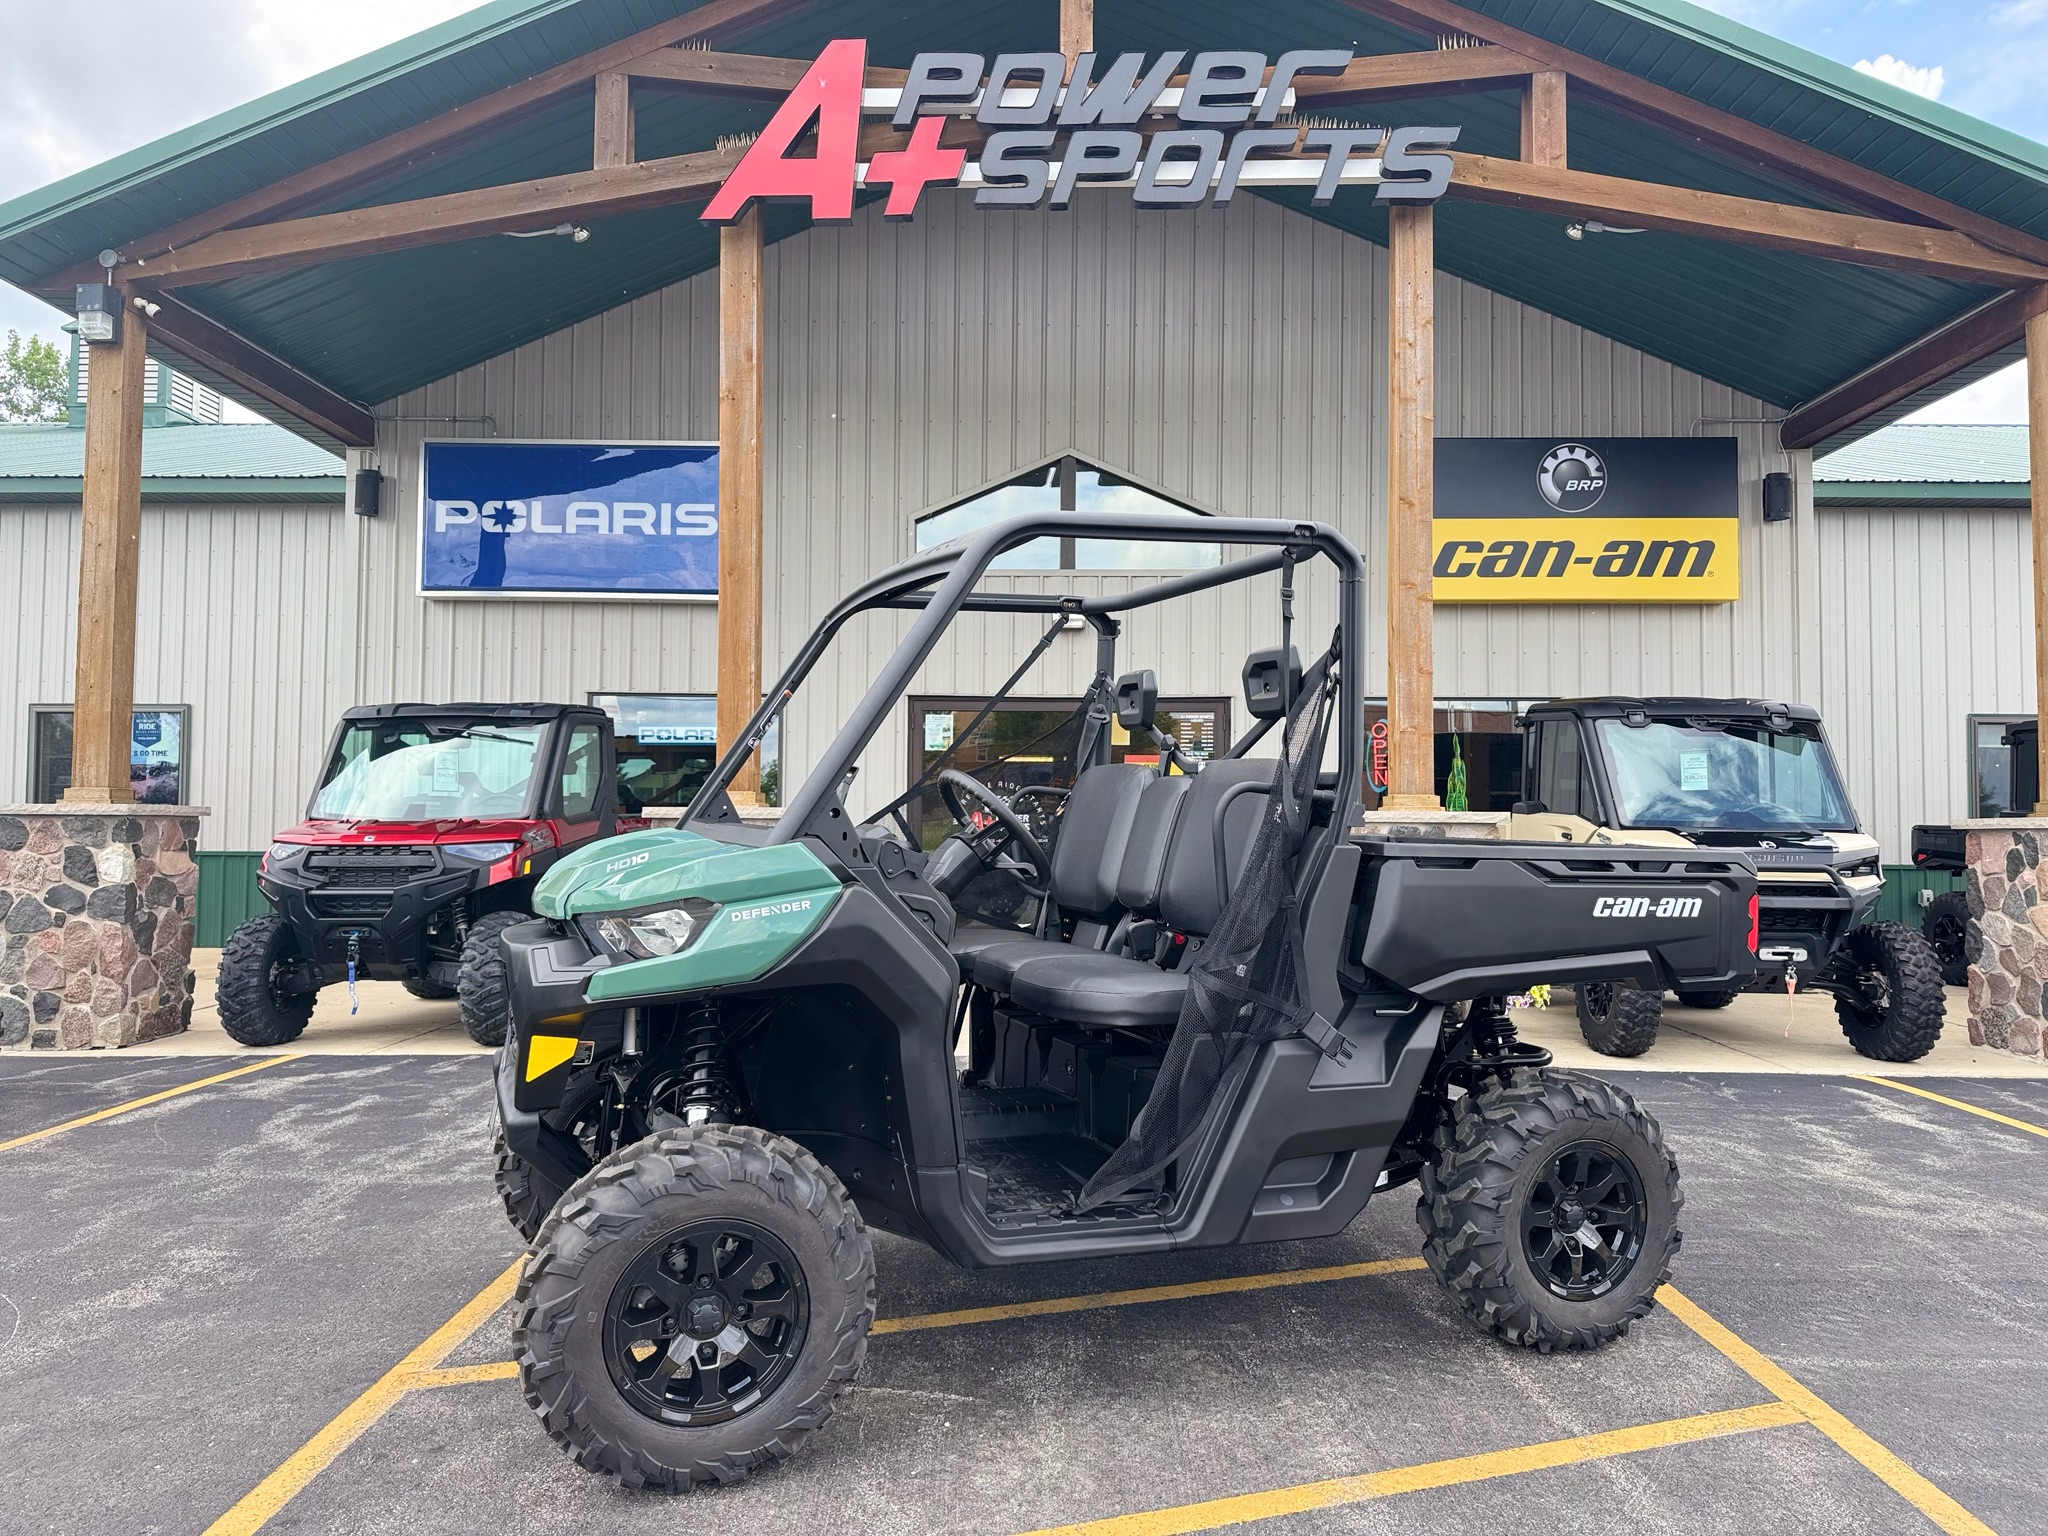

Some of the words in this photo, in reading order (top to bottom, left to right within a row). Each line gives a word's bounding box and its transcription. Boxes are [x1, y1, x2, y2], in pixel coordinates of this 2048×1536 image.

[1565, 479, 1604, 491] BRP
[434, 500, 719, 537] POLARIS
[1371, 722, 1388, 786] OPEN
[606, 852, 650, 873] HD10
[731, 900, 812, 923] DEFENDER
[1592, 897, 1703, 918] can-am
